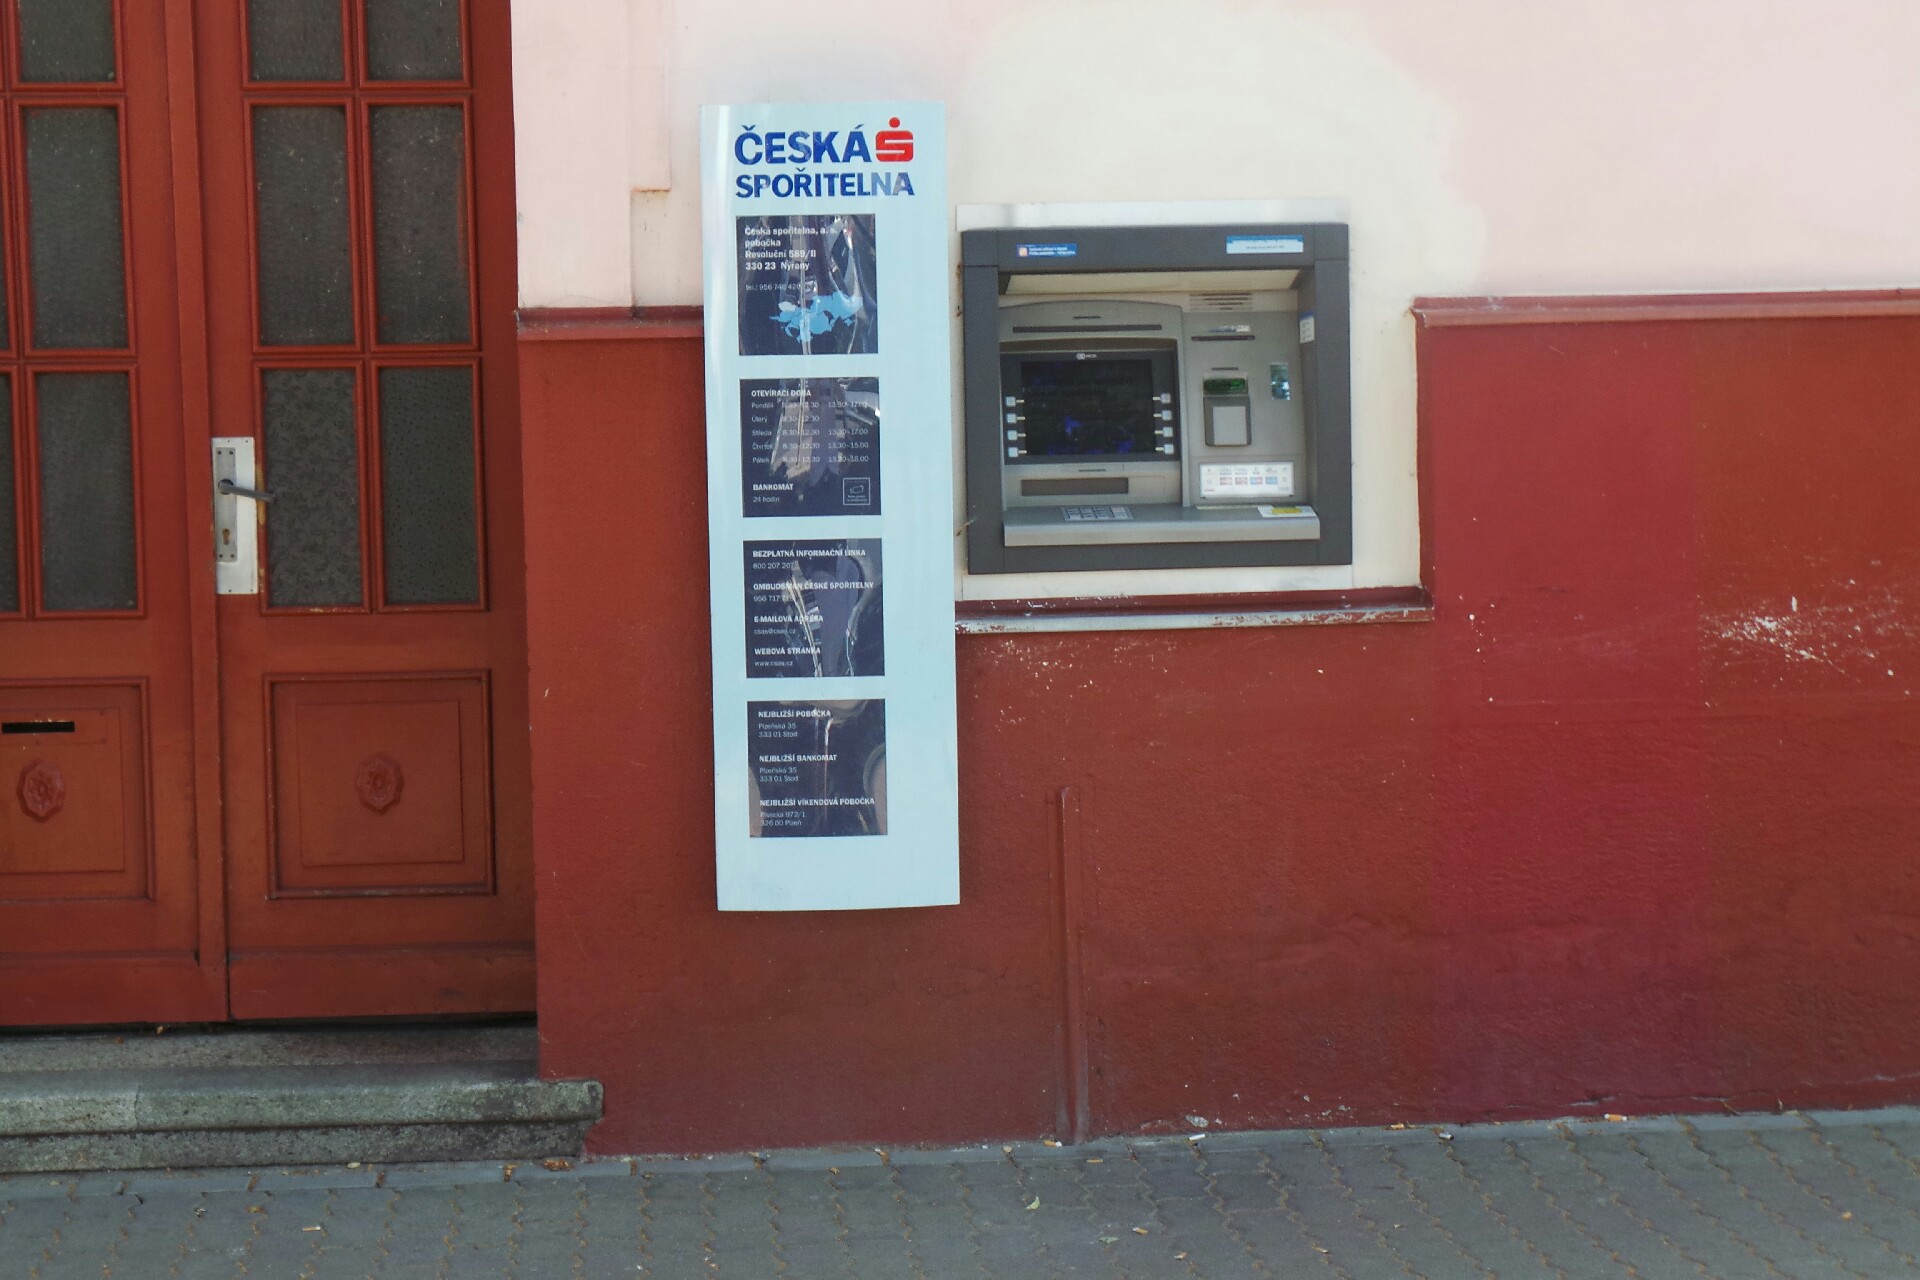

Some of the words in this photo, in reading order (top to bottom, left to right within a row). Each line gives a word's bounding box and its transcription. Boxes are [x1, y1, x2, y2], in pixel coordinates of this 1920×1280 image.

[735, 124, 872, 165] ČESKÁ
[735, 167, 915, 198] SPOŘITELNA
[745, 226, 771, 236] Česká
[773, 226, 819, 237] spořitelna,
[745, 239, 781, 248] pobočka
[745, 249, 786, 259] Revoluční
[745, 261, 763, 271] 330
[764, 261, 777, 271] 23
[751, 388, 789, 398] OTEVÍRACÍ
[752, 483, 794, 491] BANKOMAT
[752, 495, 762, 503] 24
[762, 495, 780, 503] hodin
[752, 549, 795, 558] BEZPLATNÁ
[796, 548, 843, 557] INFORMAČNÍ
[844, 549, 866, 557] LINKA
[752, 562, 767, 570] 800
[767, 562, 780, 570] 207
[804, 580, 828, 590] ČESKÉ
[830, 580, 874, 590] SPOŘITELNY
[754, 614, 793, 623] E-MAILOVÁ
[754, 646, 786, 655] WEBOVÁ
[758, 709, 795, 718] NEJBLIŽŠÍ
[795, 708, 831, 718] POBOČKA
[787, 722, 797, 730] 35
[759, 753, 795, 763] NEJBLIŽŠÍ
[796, 754, 837, 762] BANKOMAT
[788, 766, 797, 774] 35
[760, 797, 796, 807] NEJBLIŽŠÍ
[797, 796, 839, 806] VÍKENDOVÁ
[840, 796, 875, 806] POBOČKA
